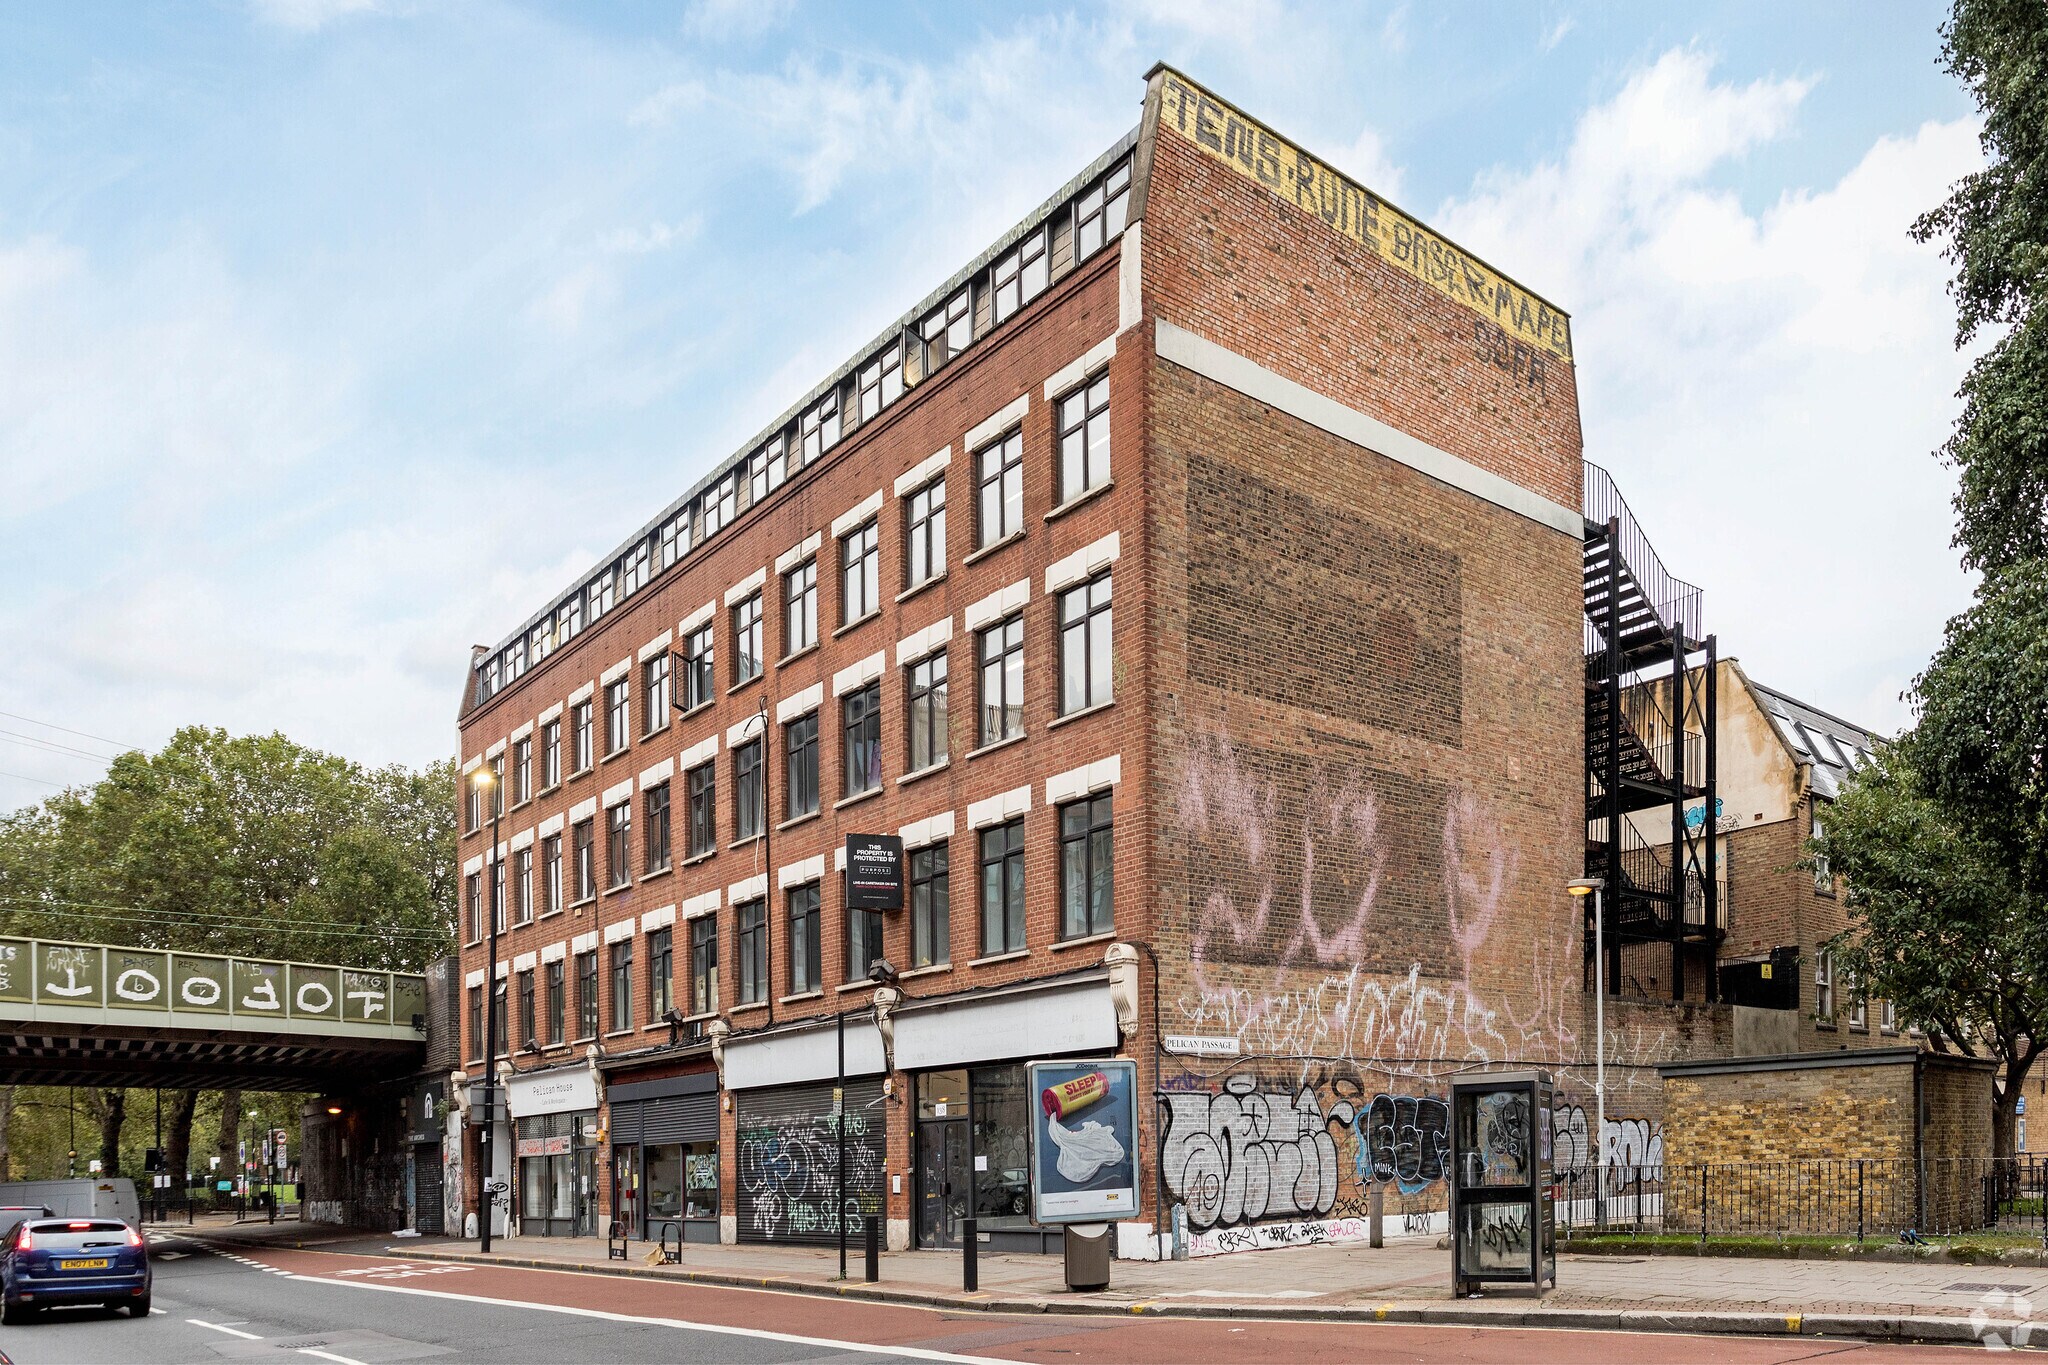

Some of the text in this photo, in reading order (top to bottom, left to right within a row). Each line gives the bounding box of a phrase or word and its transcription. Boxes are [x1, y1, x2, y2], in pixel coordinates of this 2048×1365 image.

[1167, 1039, 1232, 1049] PELICAN PASSAGE
[533, 1083, 573, 1096] Pelican House
[1064, 1075, 1097, 1095] SLEEP
